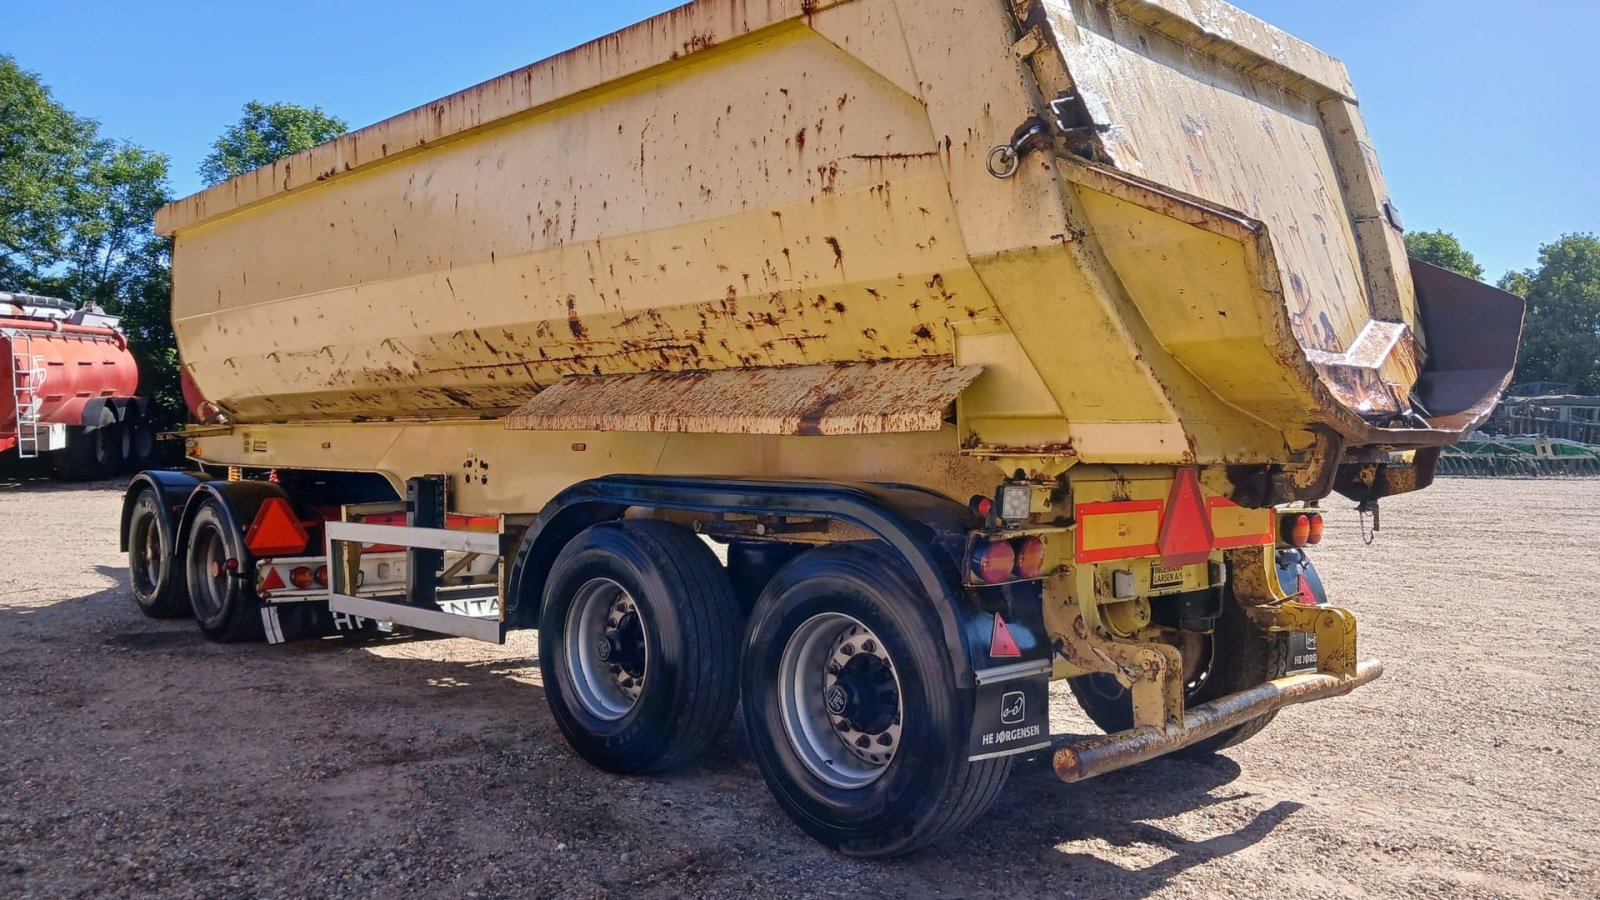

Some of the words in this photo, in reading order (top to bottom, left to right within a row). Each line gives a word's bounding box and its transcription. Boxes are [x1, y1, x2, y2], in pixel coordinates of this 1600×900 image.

[1155, 573, 1174, 583] LARSEN
[1294, 655, 1302, 665] HE
[982, 733, 994, 745] HE
[995, 724, 1040, 744] JØRGENSEN
